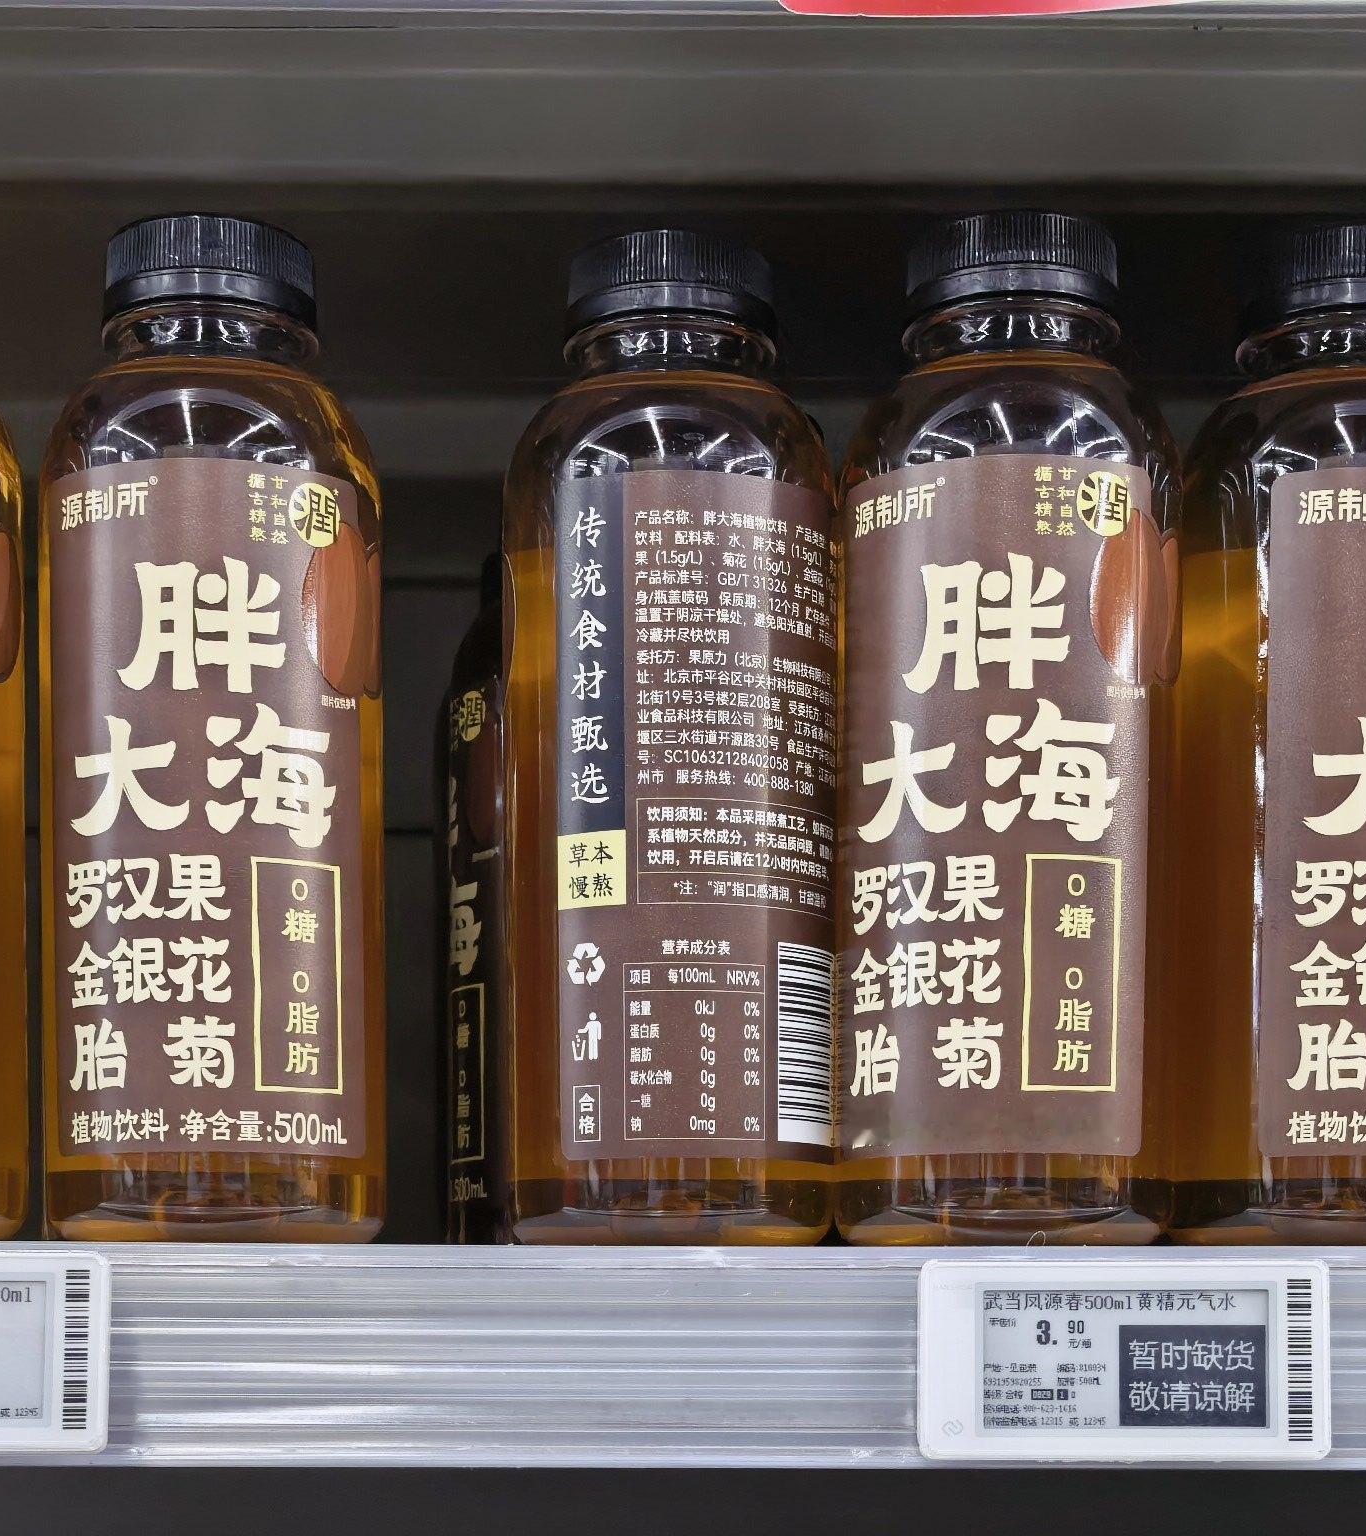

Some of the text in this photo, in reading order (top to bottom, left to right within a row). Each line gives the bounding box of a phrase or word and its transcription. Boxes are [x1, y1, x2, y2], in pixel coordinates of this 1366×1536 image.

[61, 480, 147, 530] 源制所
[855, 484, 936, 539] 源制所
[116, 560, 289, 694] 胖
[636, 628, 730, 644] 冷藏并尽快饮用
[570, 507, 609, 804] 传统食材甄选
[70, 704, 336, 849] 大海
[857, 699, 1116, 842] 大海
[568, 842, 613, 867] 草本
[67, 854, 230, 925] 罗汉果
[569, 873, 613, 899] 慢熬
[67, 938, 235, 1009] 金银花
[851, 940, 1003, 1015] 金银花
[630, 1001, 759, 1016] 能量 0kJ 0%
[630, 1024, 716, 1041] 蛋白质 0g
[630, 1070, 672, 1085] 碳水化合物
[71, 1112, 346, 1145] 植物饮料 净含量:500mL
[1129, 1339, 1255, 1372] 暂时缺货
[1129, 1381, 1255, 1413] 敬请谅解
